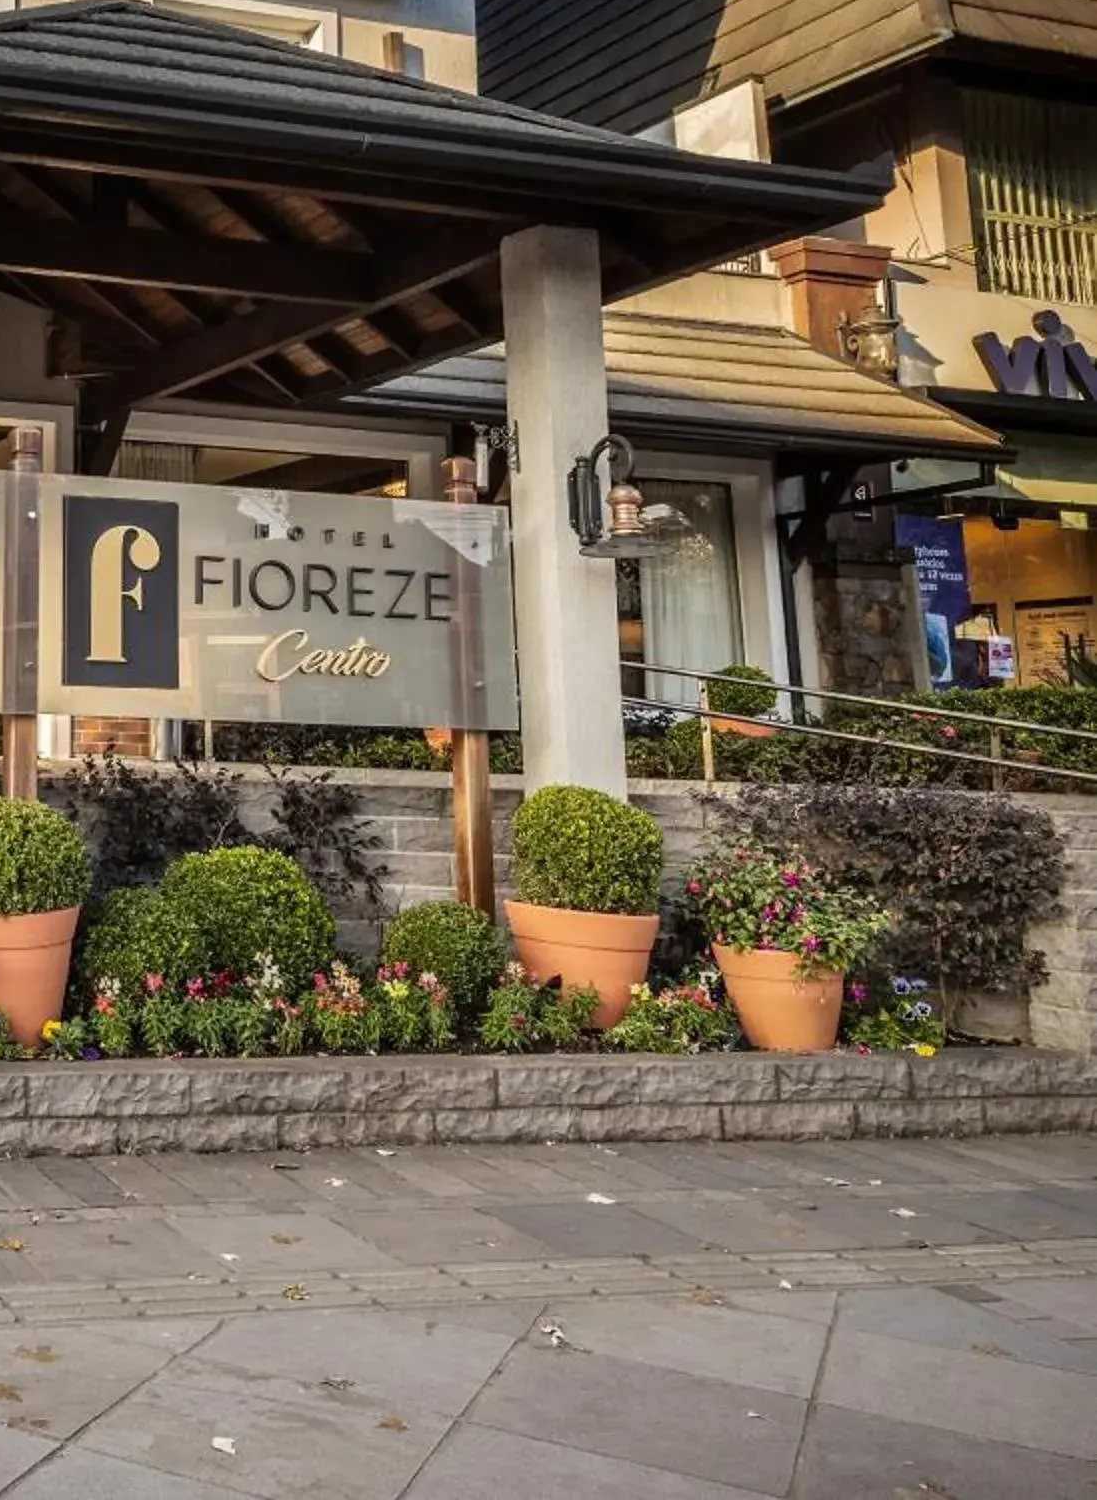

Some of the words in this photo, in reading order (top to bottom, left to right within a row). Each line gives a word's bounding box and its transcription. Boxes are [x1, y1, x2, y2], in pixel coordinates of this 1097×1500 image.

[254, 523, 395, 549] HOTEL
[194, 555, 452, 621] FIOREZE
[257, 628, 392, 682] Centro
